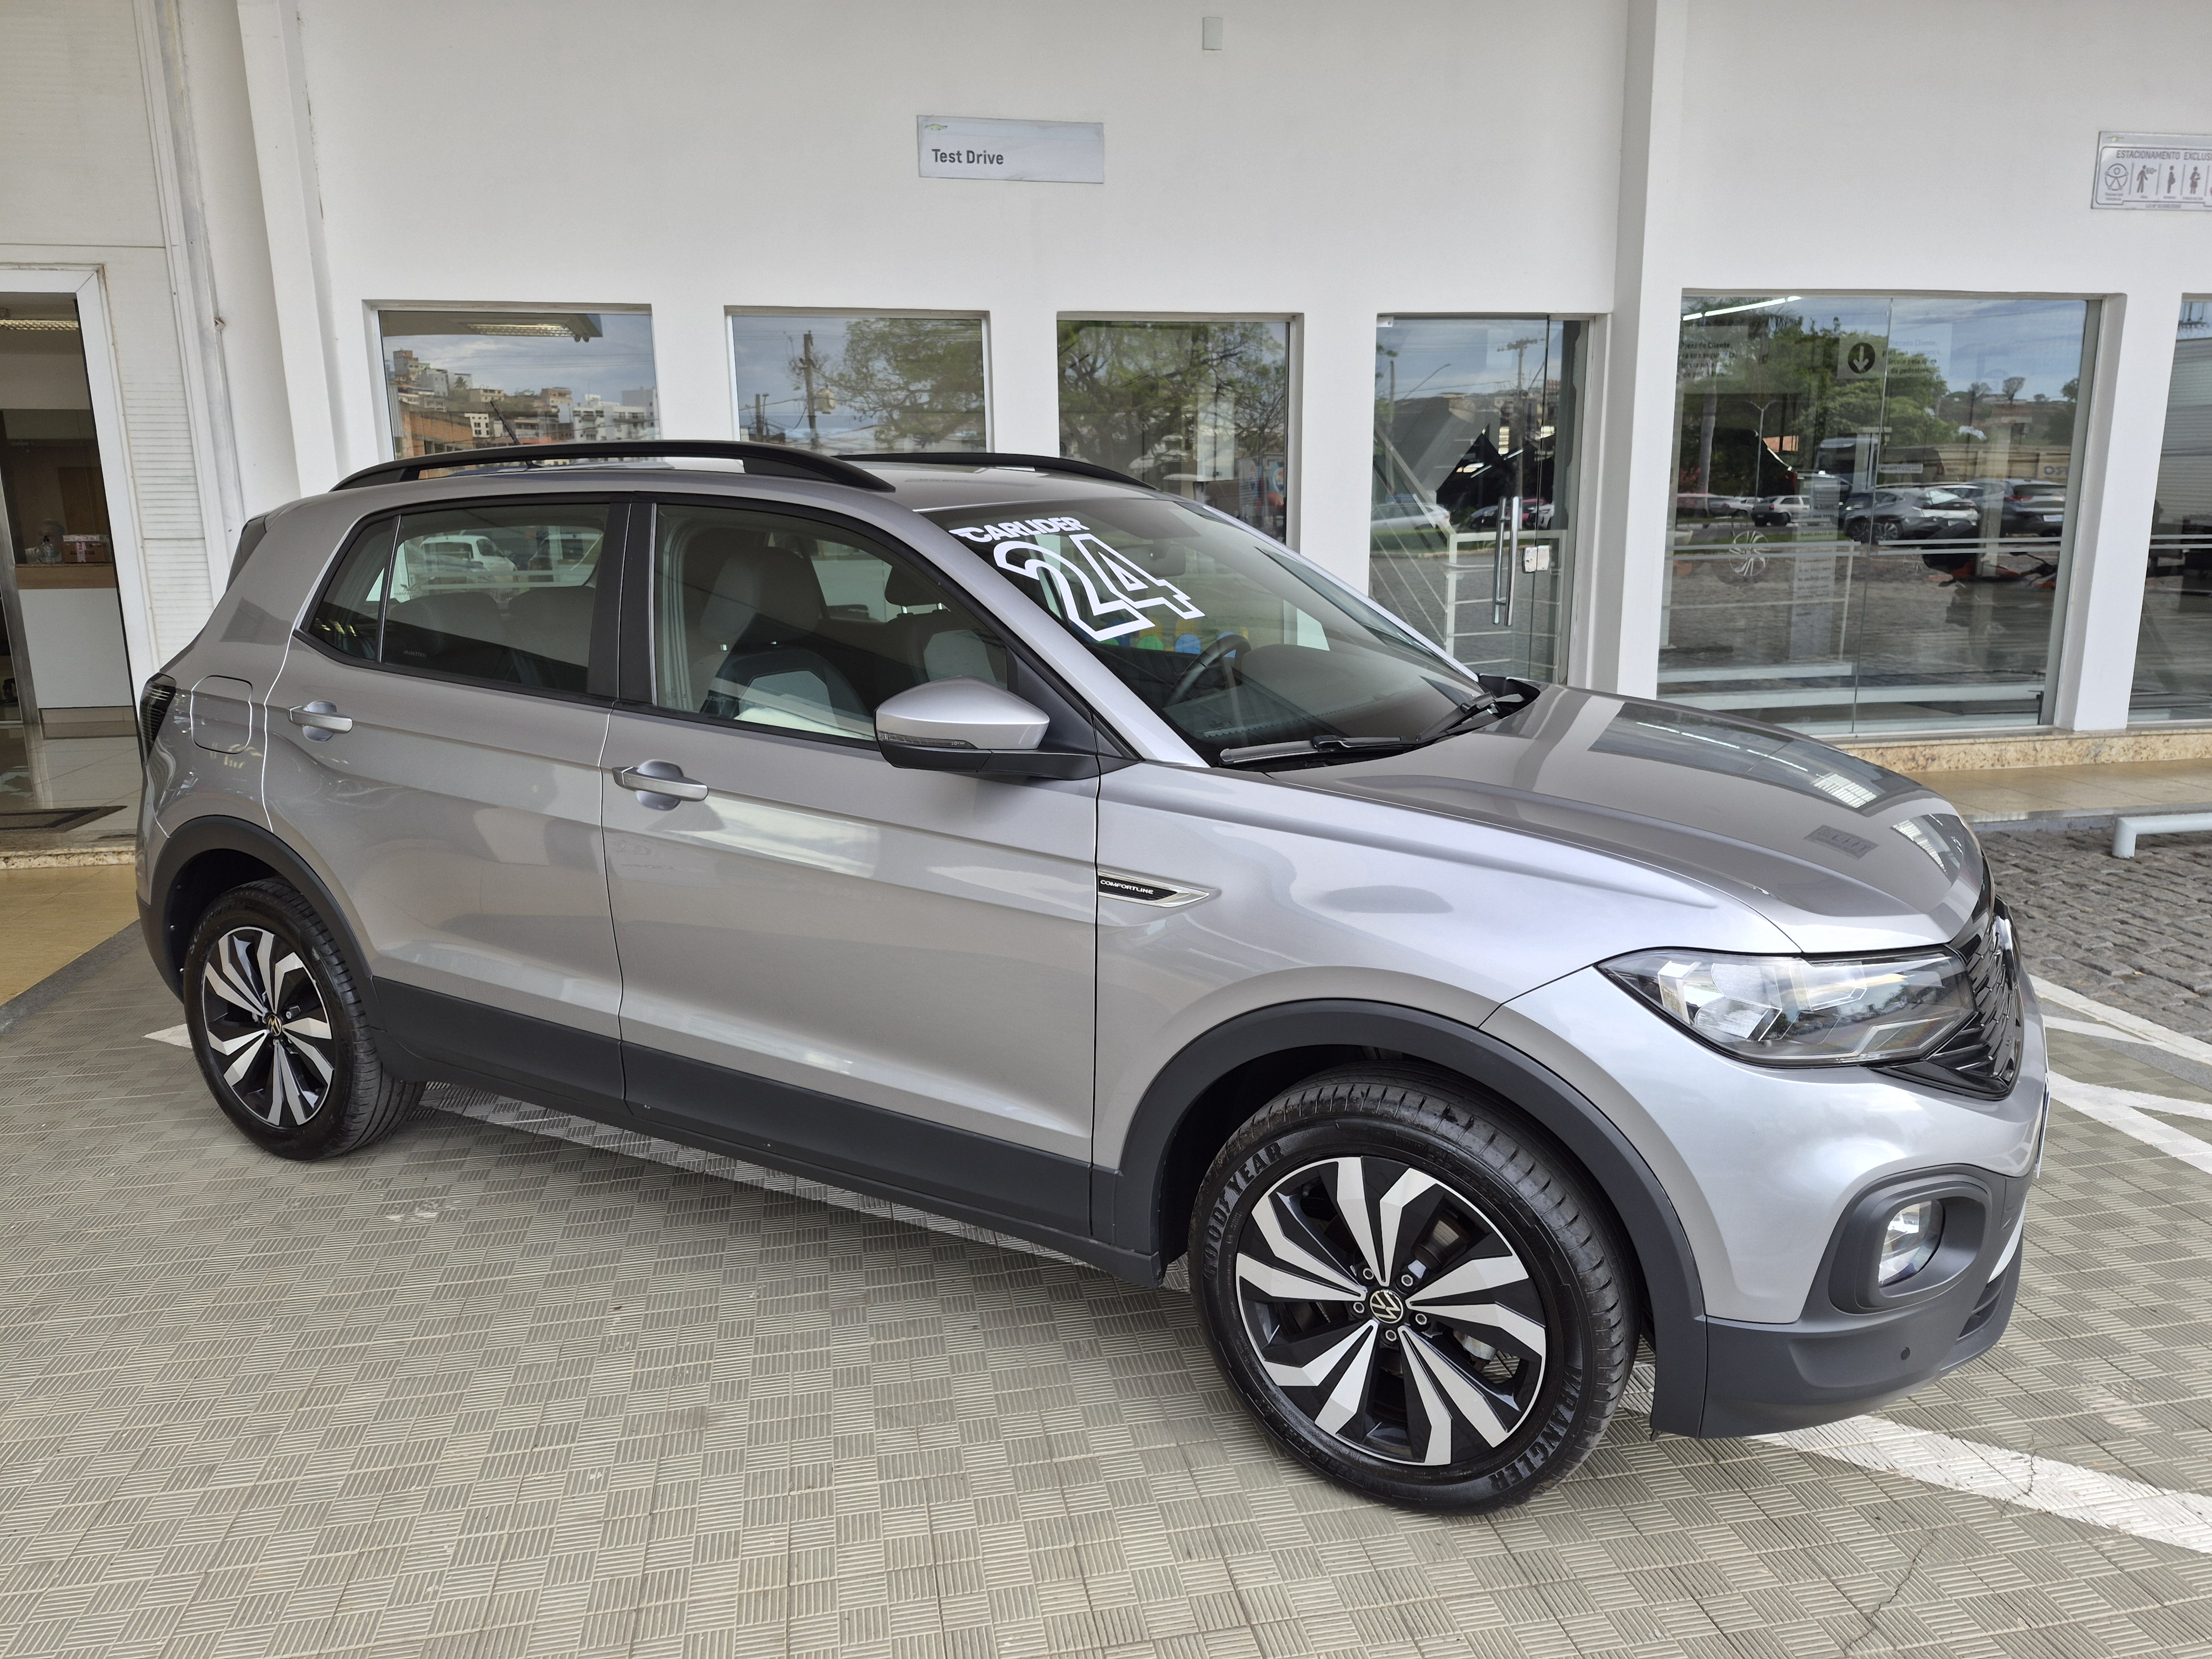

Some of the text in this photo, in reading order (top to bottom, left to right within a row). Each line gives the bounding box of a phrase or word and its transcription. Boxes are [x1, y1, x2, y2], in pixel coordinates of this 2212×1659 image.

[931, 149, 1004, 165] Test Drive
[2116, 150, 2180, 160] ESTACIONAMENTO
[949, 517, 1091, 542] CARLIDER
[994, 533, 1206, 641] 24
[1100, 879, 1154, 895] COMFORTLINE
[1203, 1141, 1285, 1280] GOODYEAR
[1488, 1364, 1583, 1493] WRANGLER
